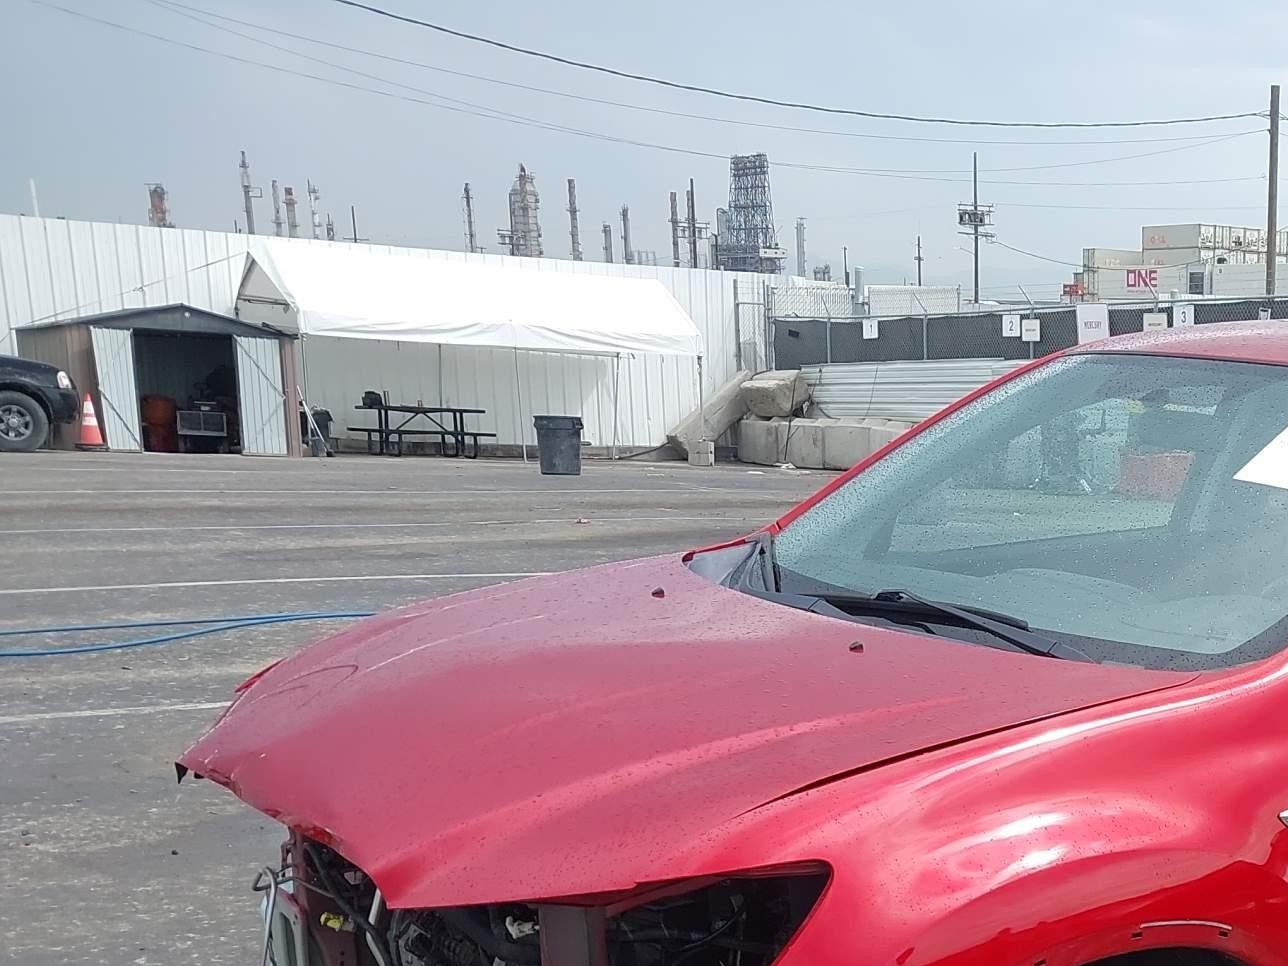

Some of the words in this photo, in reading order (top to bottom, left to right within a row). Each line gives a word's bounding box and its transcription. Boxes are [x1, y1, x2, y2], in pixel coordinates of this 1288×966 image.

[1126, 269, 1158, 288] ONE
[1181, 311, 1187, 323] 3
[1008, 320, 1014, 332] 2
